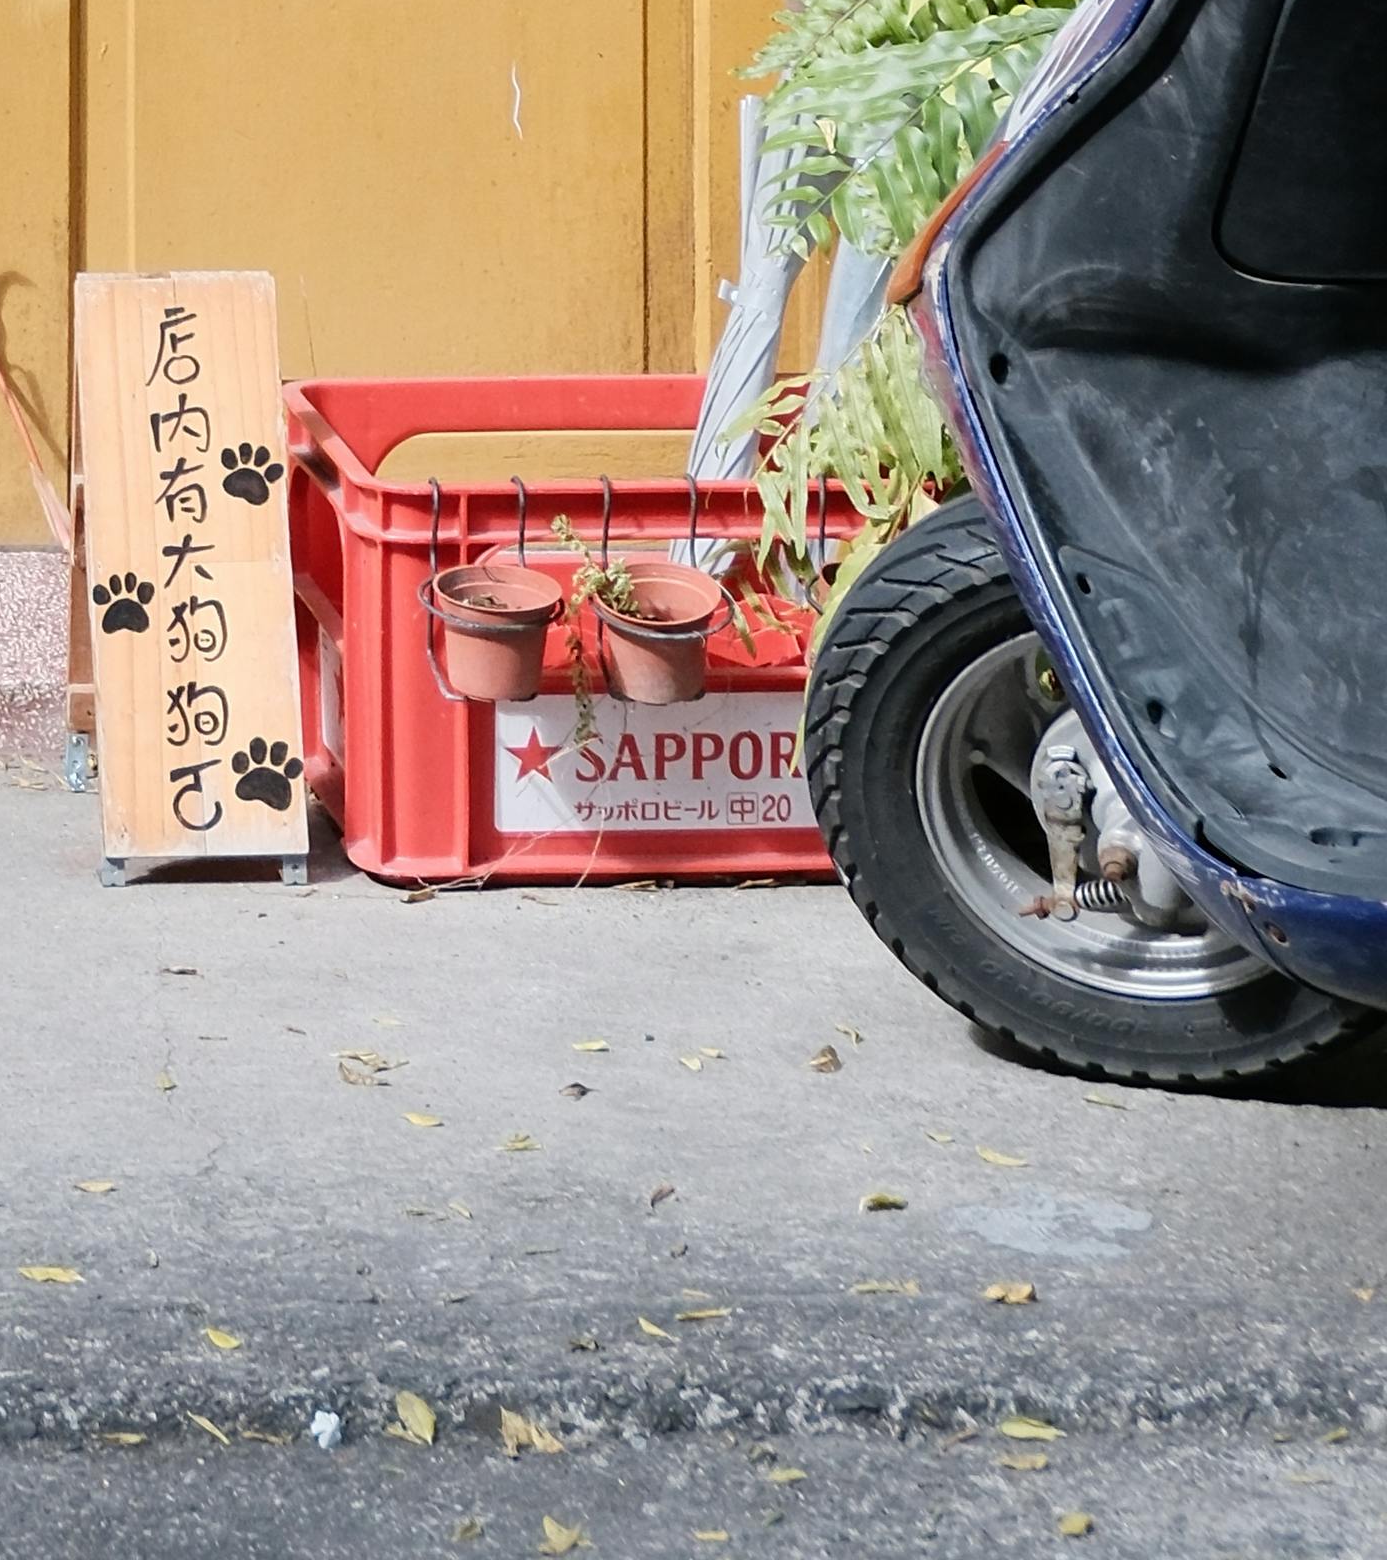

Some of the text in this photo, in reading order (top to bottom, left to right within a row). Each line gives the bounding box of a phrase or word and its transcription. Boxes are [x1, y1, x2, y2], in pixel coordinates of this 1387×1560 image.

[574, 797, 720, 823] サッポロビール
[761, 793, 792, 823] 20
